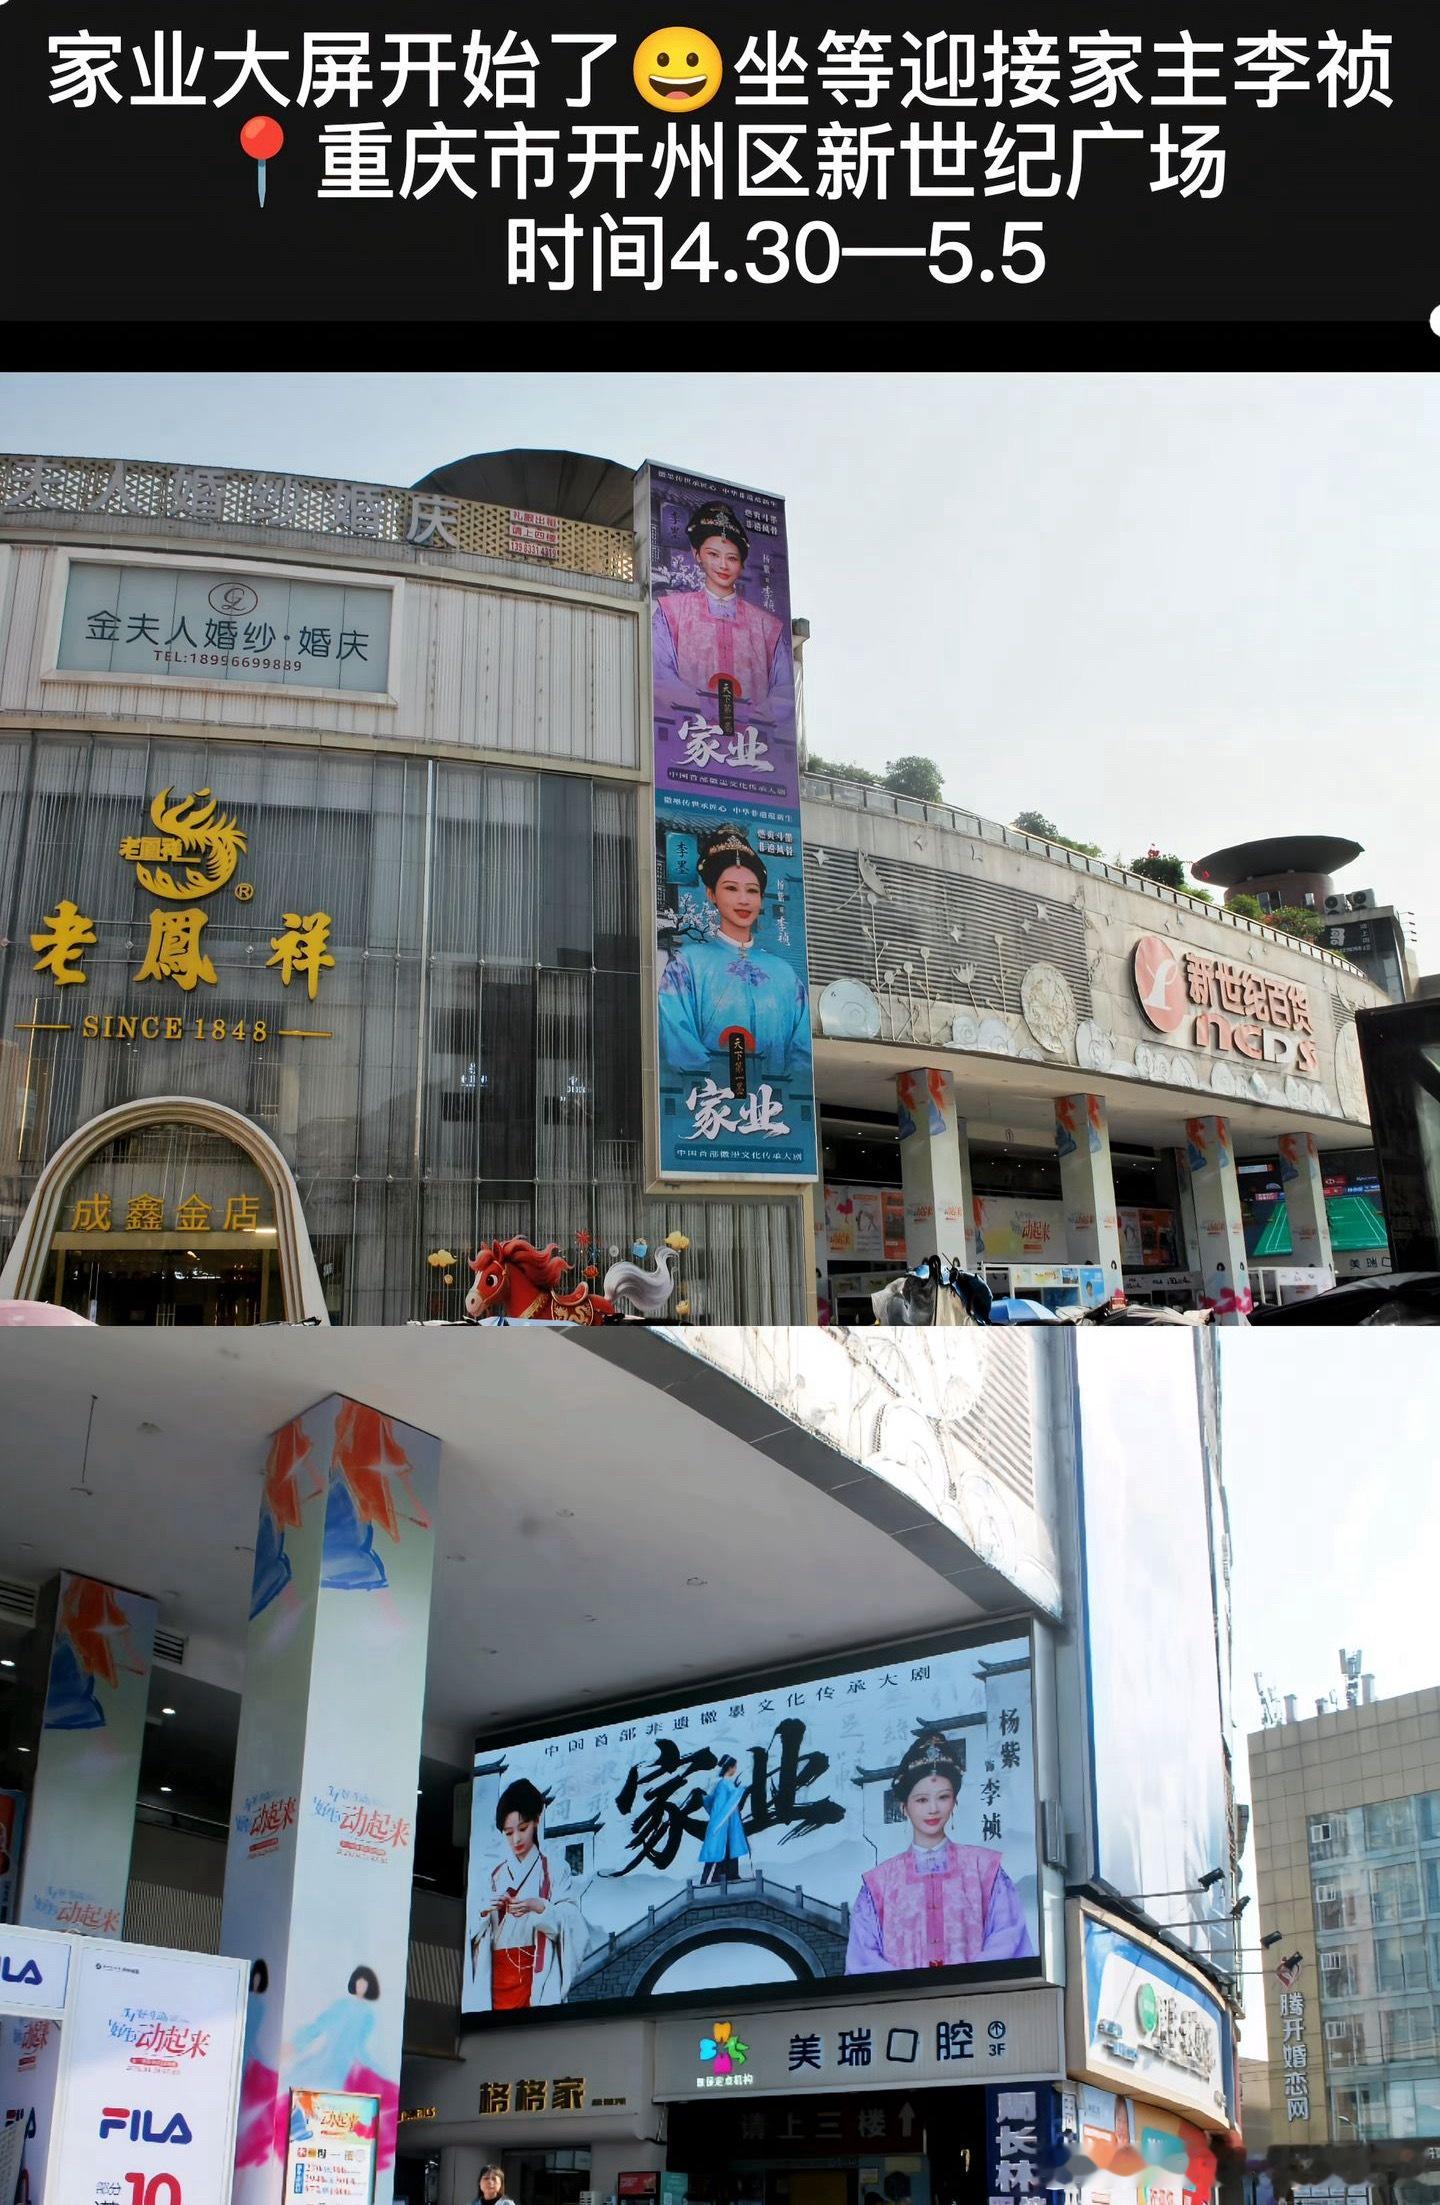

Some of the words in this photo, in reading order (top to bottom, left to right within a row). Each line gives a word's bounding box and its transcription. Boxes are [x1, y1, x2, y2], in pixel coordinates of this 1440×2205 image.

[670, 713, 775, 772] 家业
[1184, 952, 1314, 1035] 新世纪百货
[82, 1015, 184, 1040] SINCE
[194, 1018, 268, 1042] 1848
[678, 1077, 791, 1140] 家业
[71, 1192, 261, 1232] 成鑫金店
[998, 1708, 1021, 1769] 杨紫
[600, 1717, 846, 1878] 家业
[0, 1956, 43, 1985] LA
[788, 2019, 975, 2071] 美瑞口腔
[988, 2043, 1006, 2057] 3F
[1280, 1991, 1310, 2123] 腾开婚恋网
[479, 2075, 585, 2115] 格格家
[99, 2107, 193, 2145] FILA
